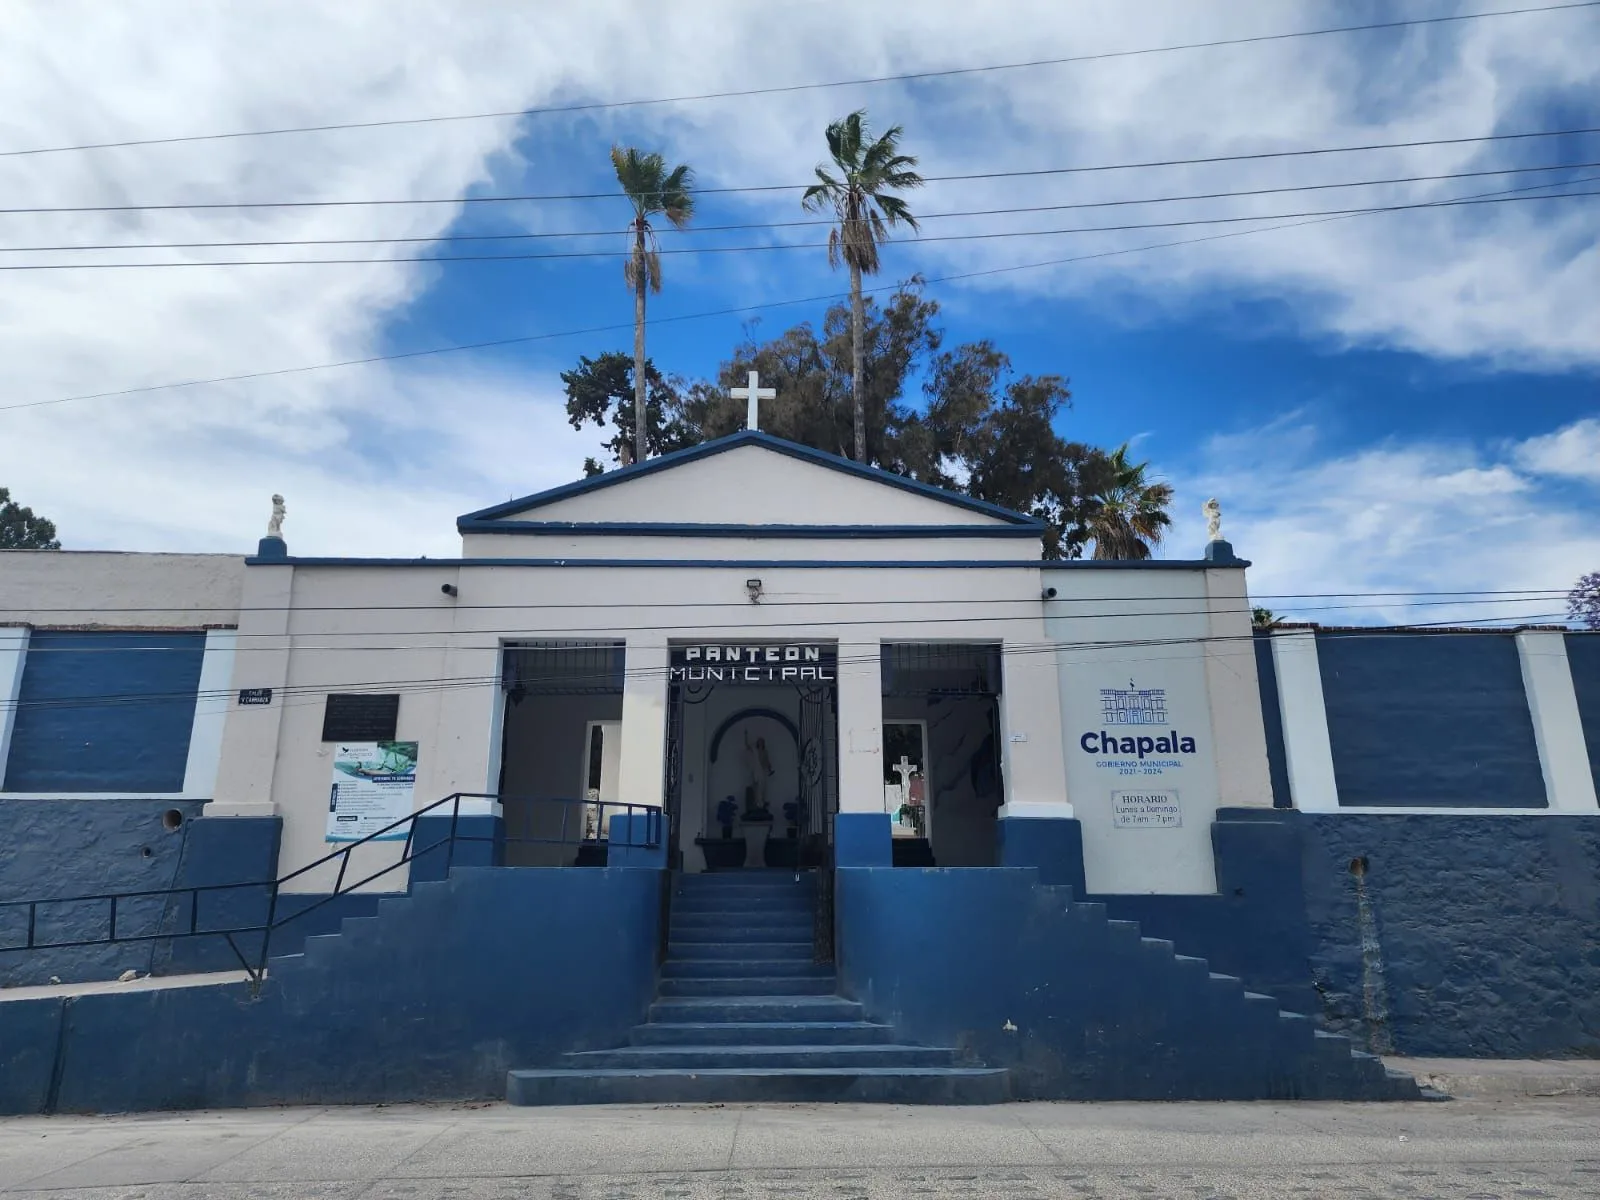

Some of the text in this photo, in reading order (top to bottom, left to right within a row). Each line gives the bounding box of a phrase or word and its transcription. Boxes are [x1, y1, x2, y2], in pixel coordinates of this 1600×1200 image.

[686, 647, 820, 663] PANTEON
[670, 667, 834, 681] MUNICIPAL
[1080, 730, 1196, 759] Chapala
[1122, 795, 1168, 804] HORARIO
[1116, 805, 1138, 813] Lunes
[1146, 805, 1178, 814] Domingo
[1120, 815, 1131, 823] de
